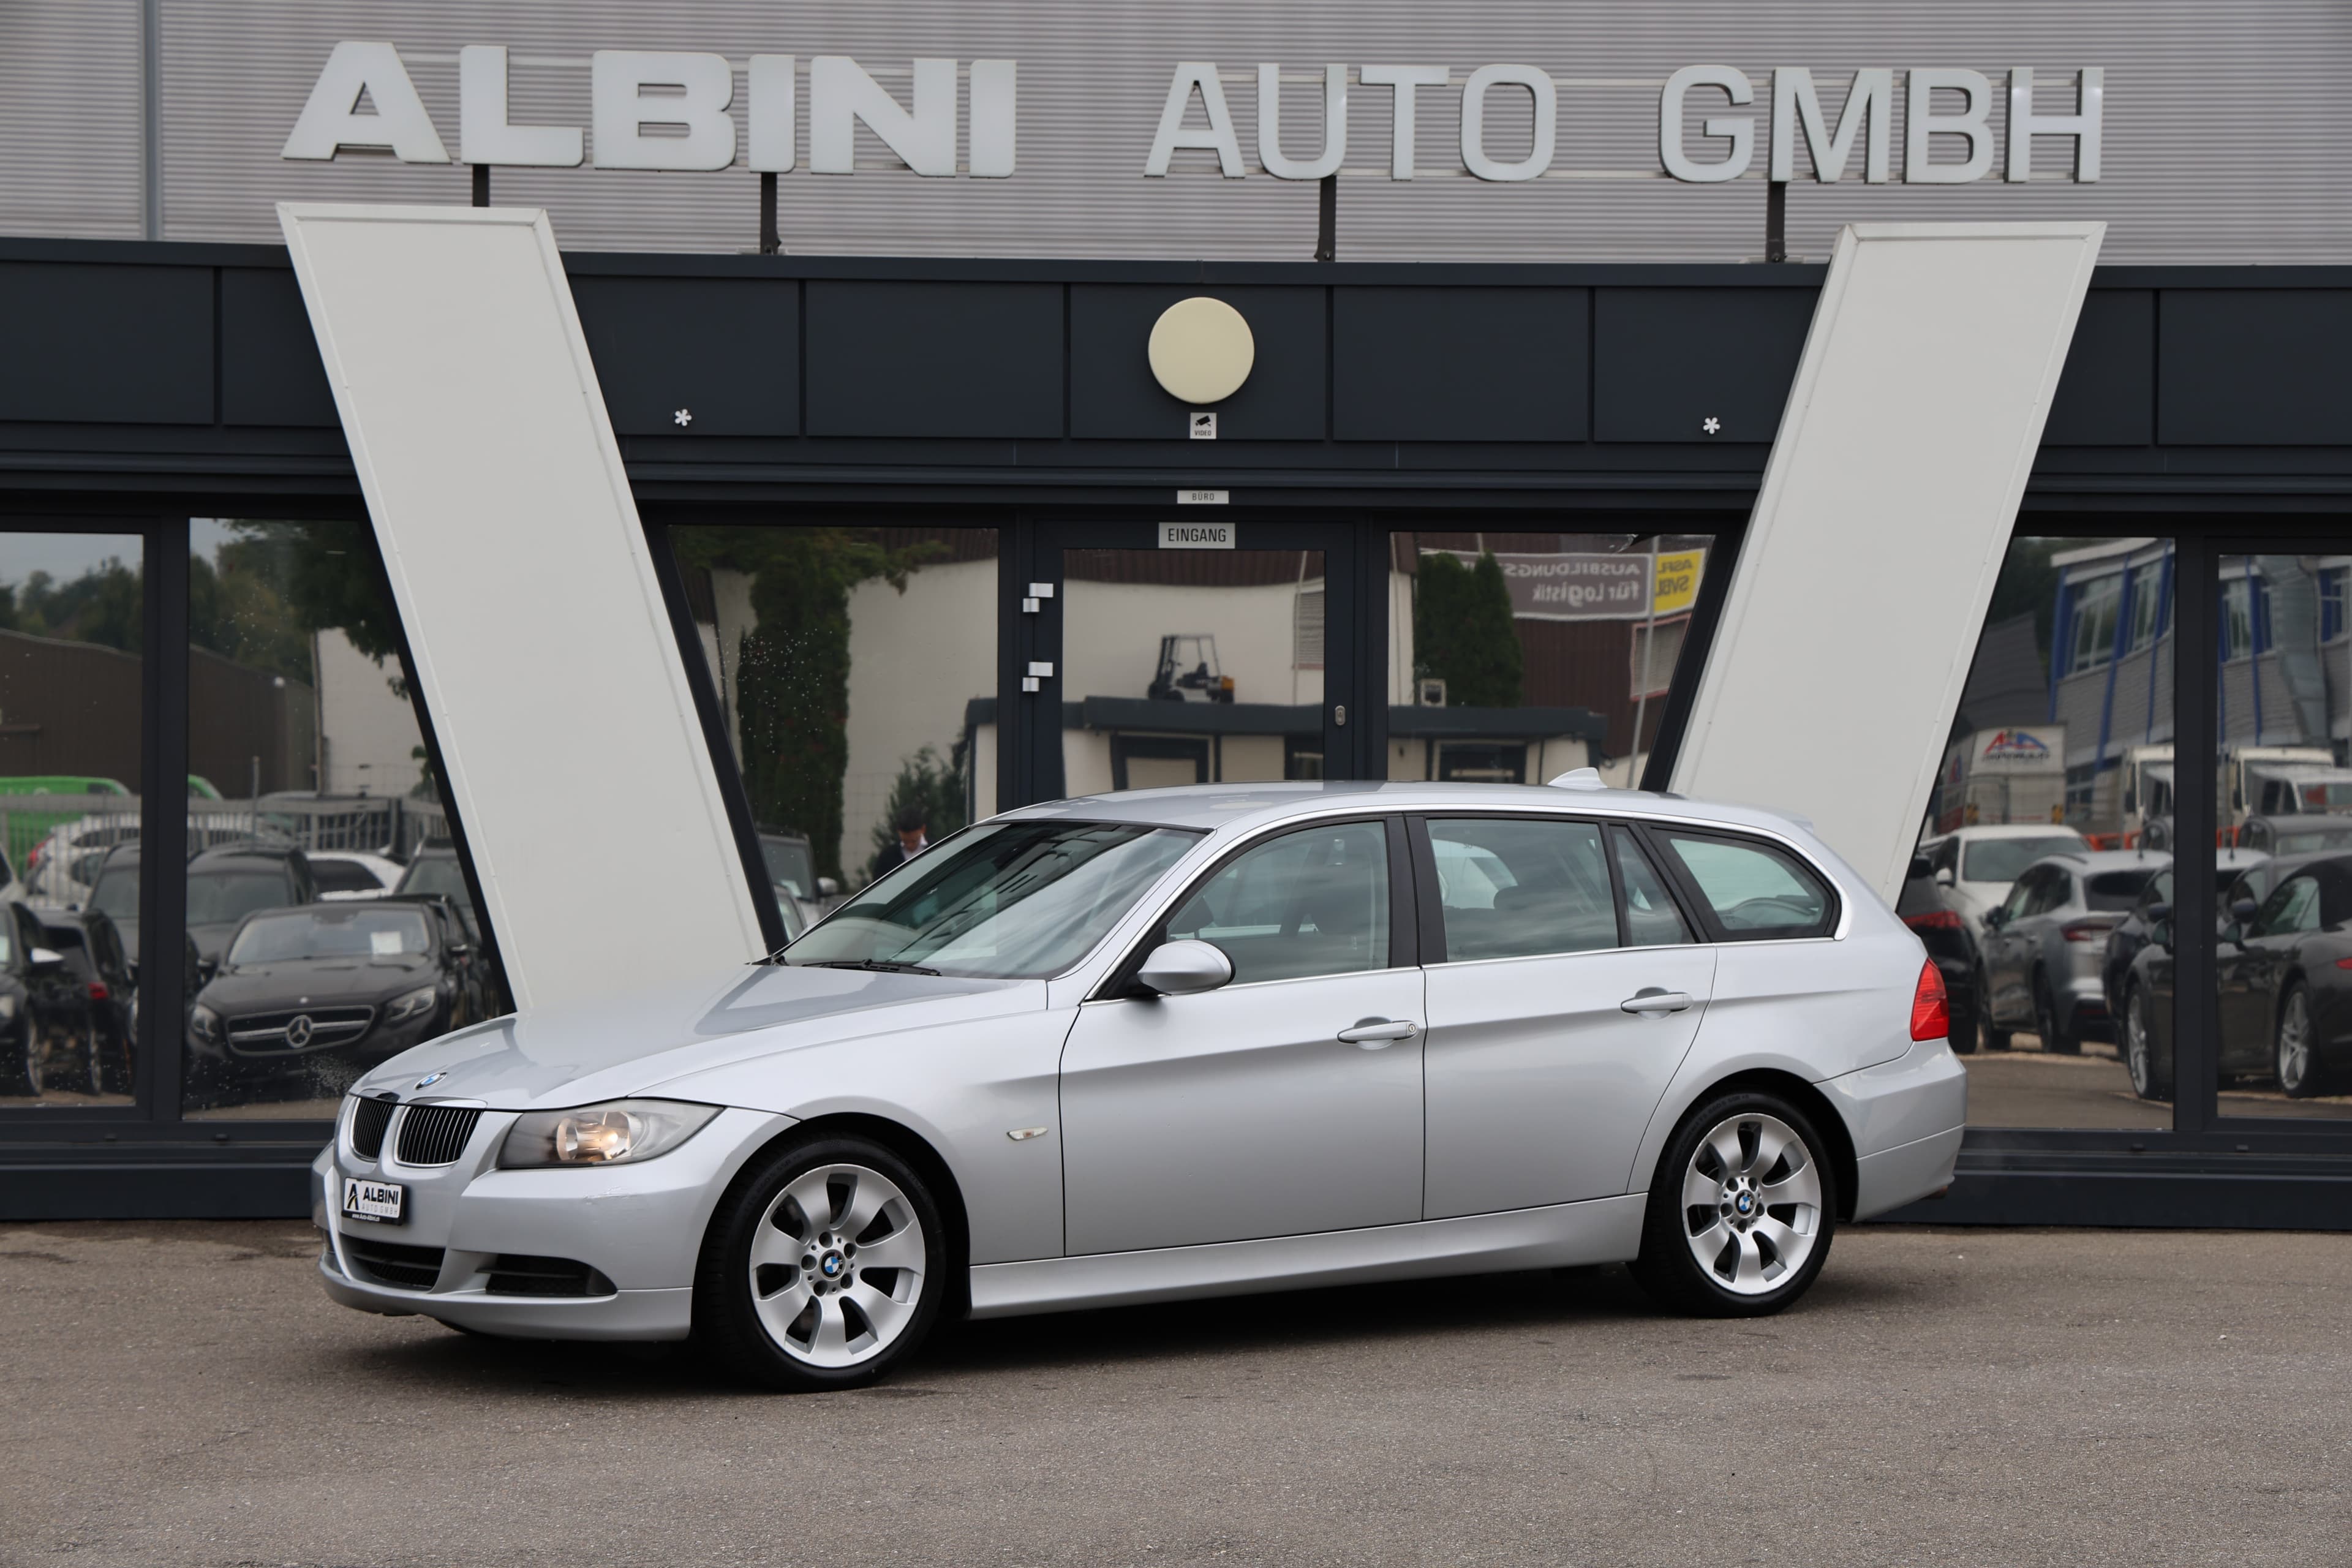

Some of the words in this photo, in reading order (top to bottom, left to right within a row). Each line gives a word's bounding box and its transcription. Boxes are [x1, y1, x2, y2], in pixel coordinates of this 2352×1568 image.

[281, 40, 1017, 179] ALBINI
[1144, 61, 1558, 182] AUTO
[1658, 64, 2105, 184] GMBH
[1192, 492, 1215, 501] BÜRO
[1167, 528, 1226, 543] EINGANG
[363, 1186, 399, 1205] ALBINI
